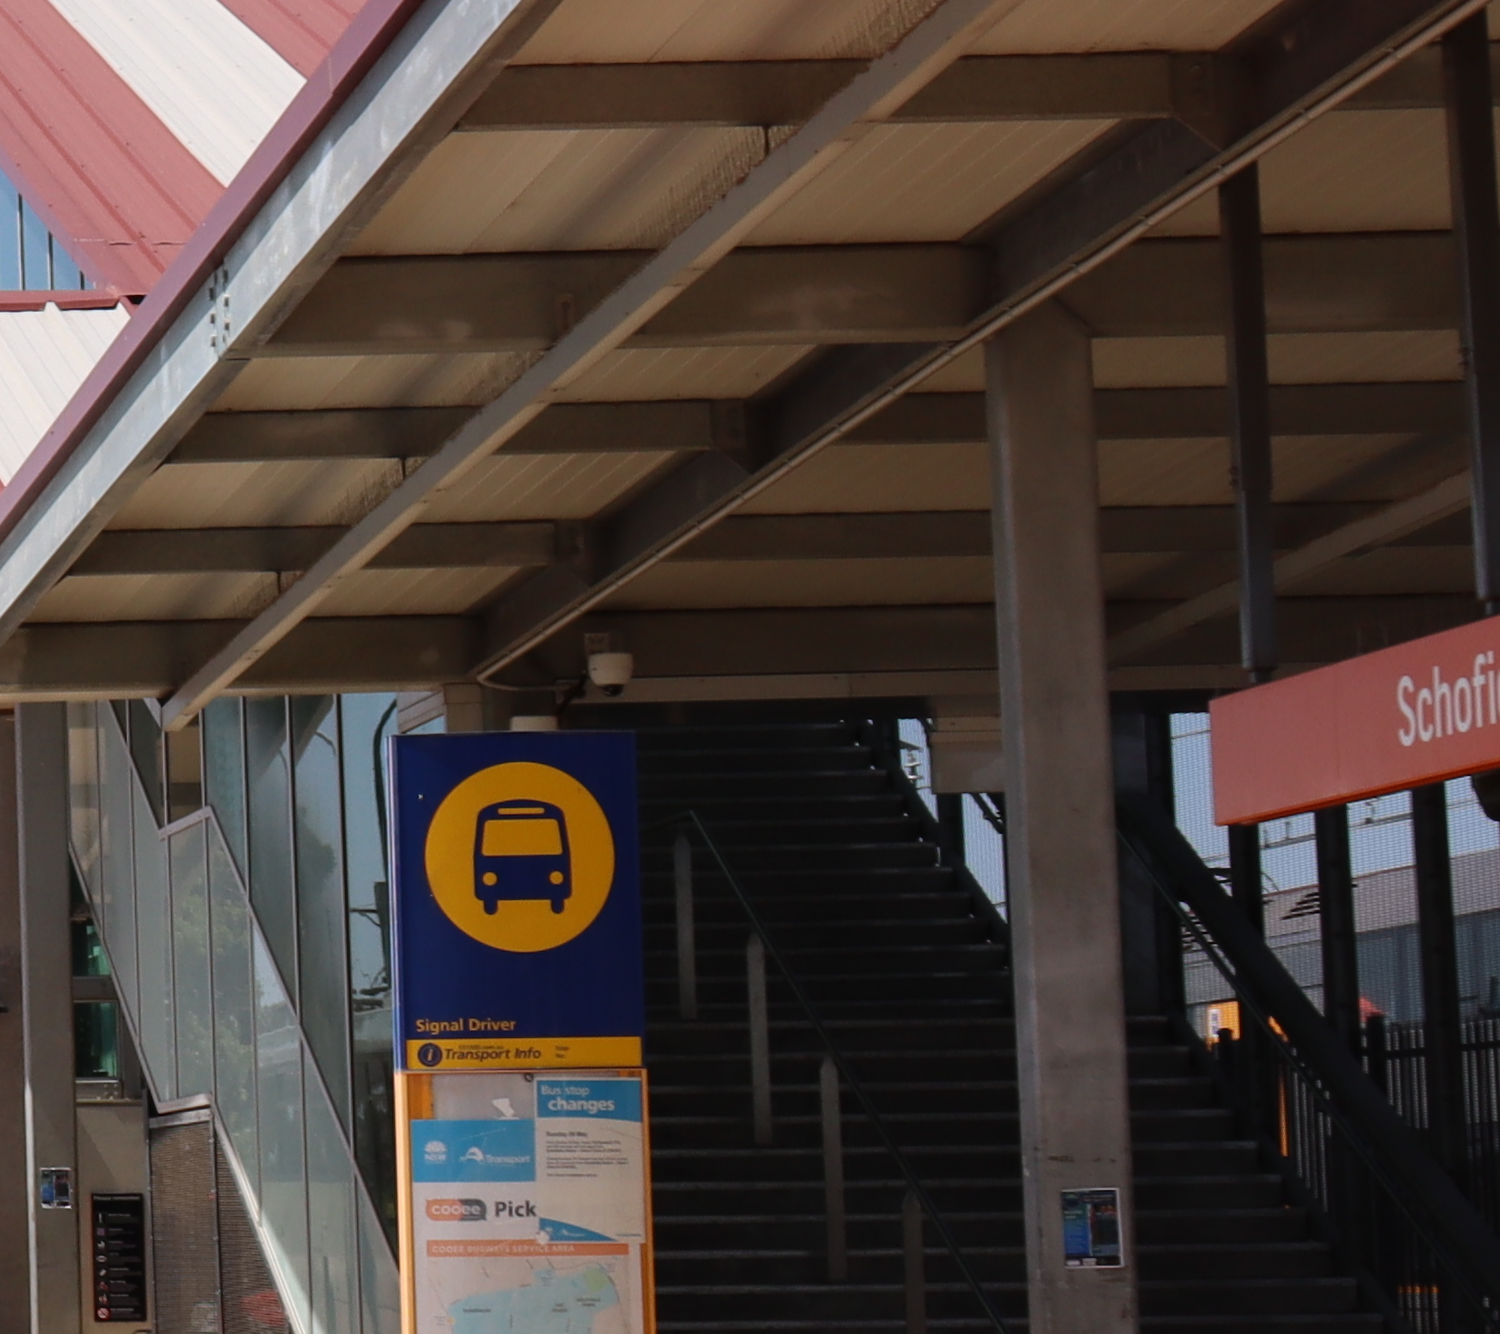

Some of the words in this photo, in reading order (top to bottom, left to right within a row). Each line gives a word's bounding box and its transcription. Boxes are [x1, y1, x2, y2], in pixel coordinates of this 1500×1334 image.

[1397, 650, 1500, 747] Schofi
[415, 1018, 464, 1035] Signal
[469, 1018, 516, 1032] Driver
[444, 1047, 511, 1063] Transport
[514, 1046, 542, 1060] Info
[541, 1085, 560, 1096] Bus
[564, 1085, 590, 1097] stop
[547, 1097, 615, 1114] changes
[424, 1152, 447, 1162] NSW
[485, 1153, 531, 1164] Transport
[431, 1203, 481, 1216] cooee
[494, 1200, 536, 1218] Pick
